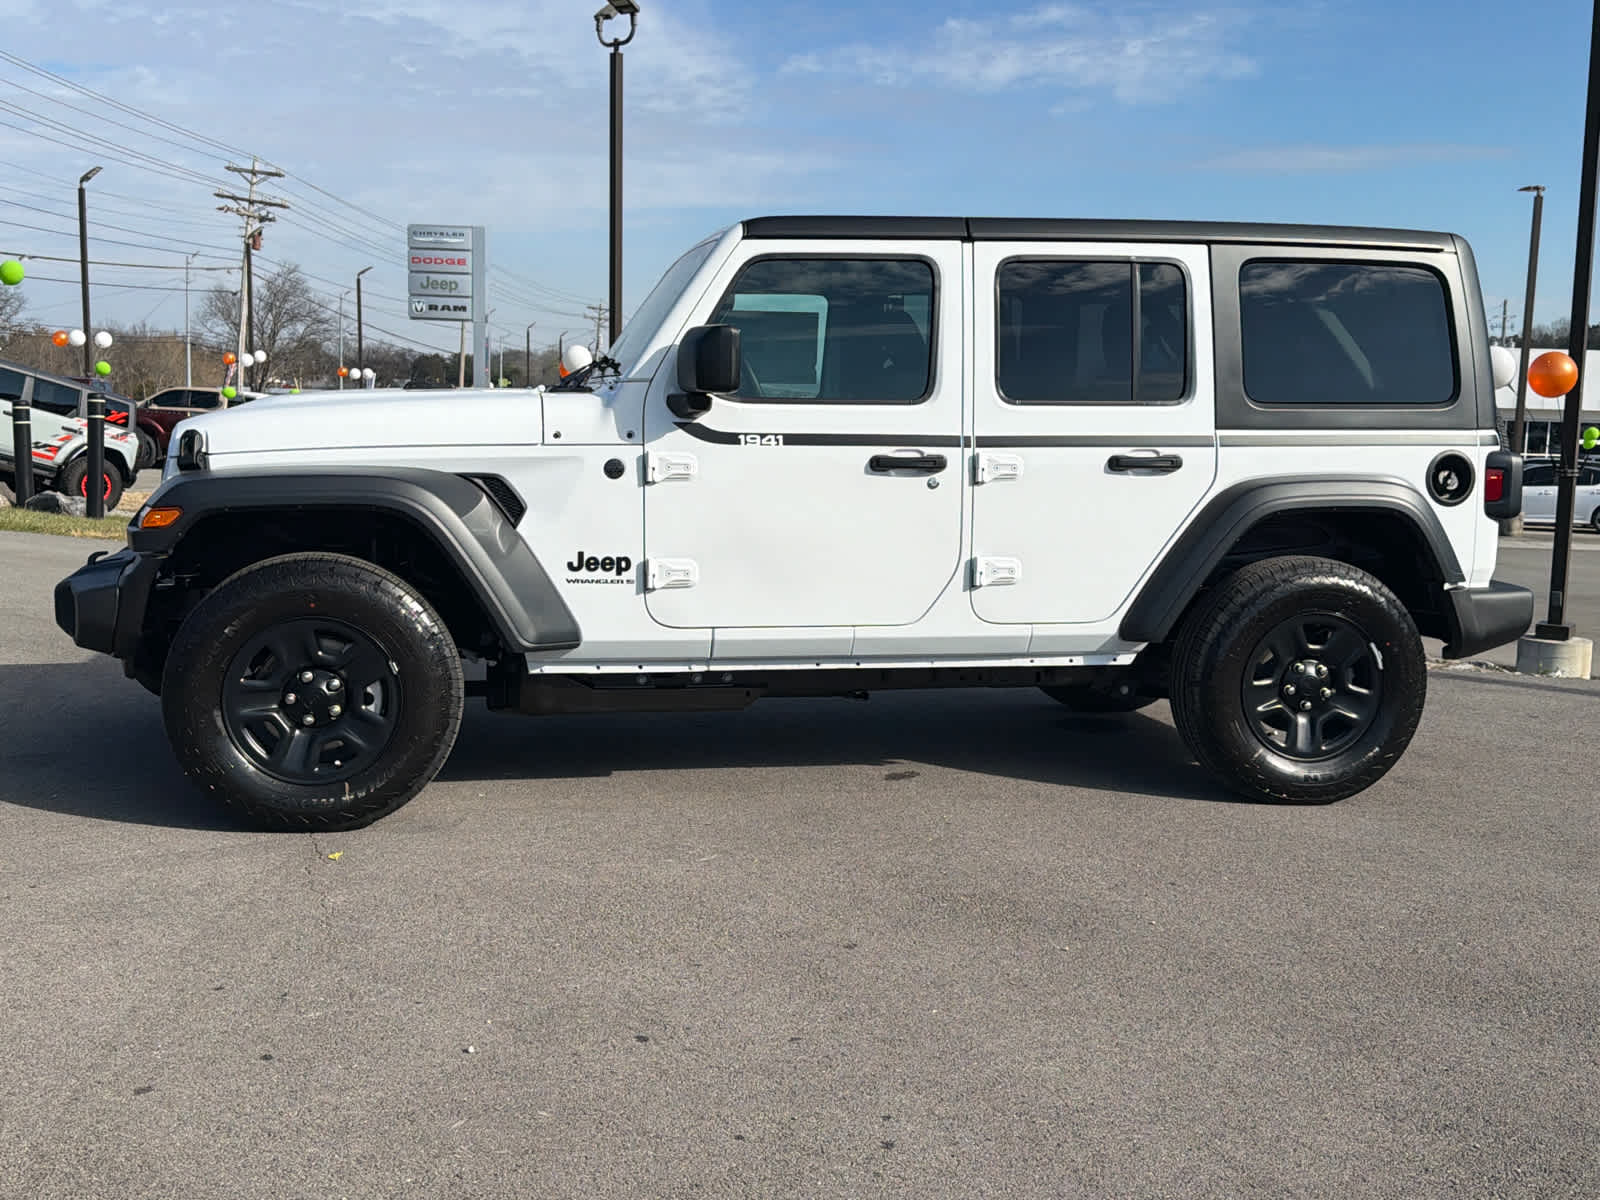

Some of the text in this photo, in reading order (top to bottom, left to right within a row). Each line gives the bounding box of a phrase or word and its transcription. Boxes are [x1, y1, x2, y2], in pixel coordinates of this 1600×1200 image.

[411, 256, 467, 266] DODGE
[420, 276, 458, 293] Jeep
[428, 304, 467, 312] RAM
[738, 434, 784, 446] 1941
[567, 551, 632, 576] Jeep
